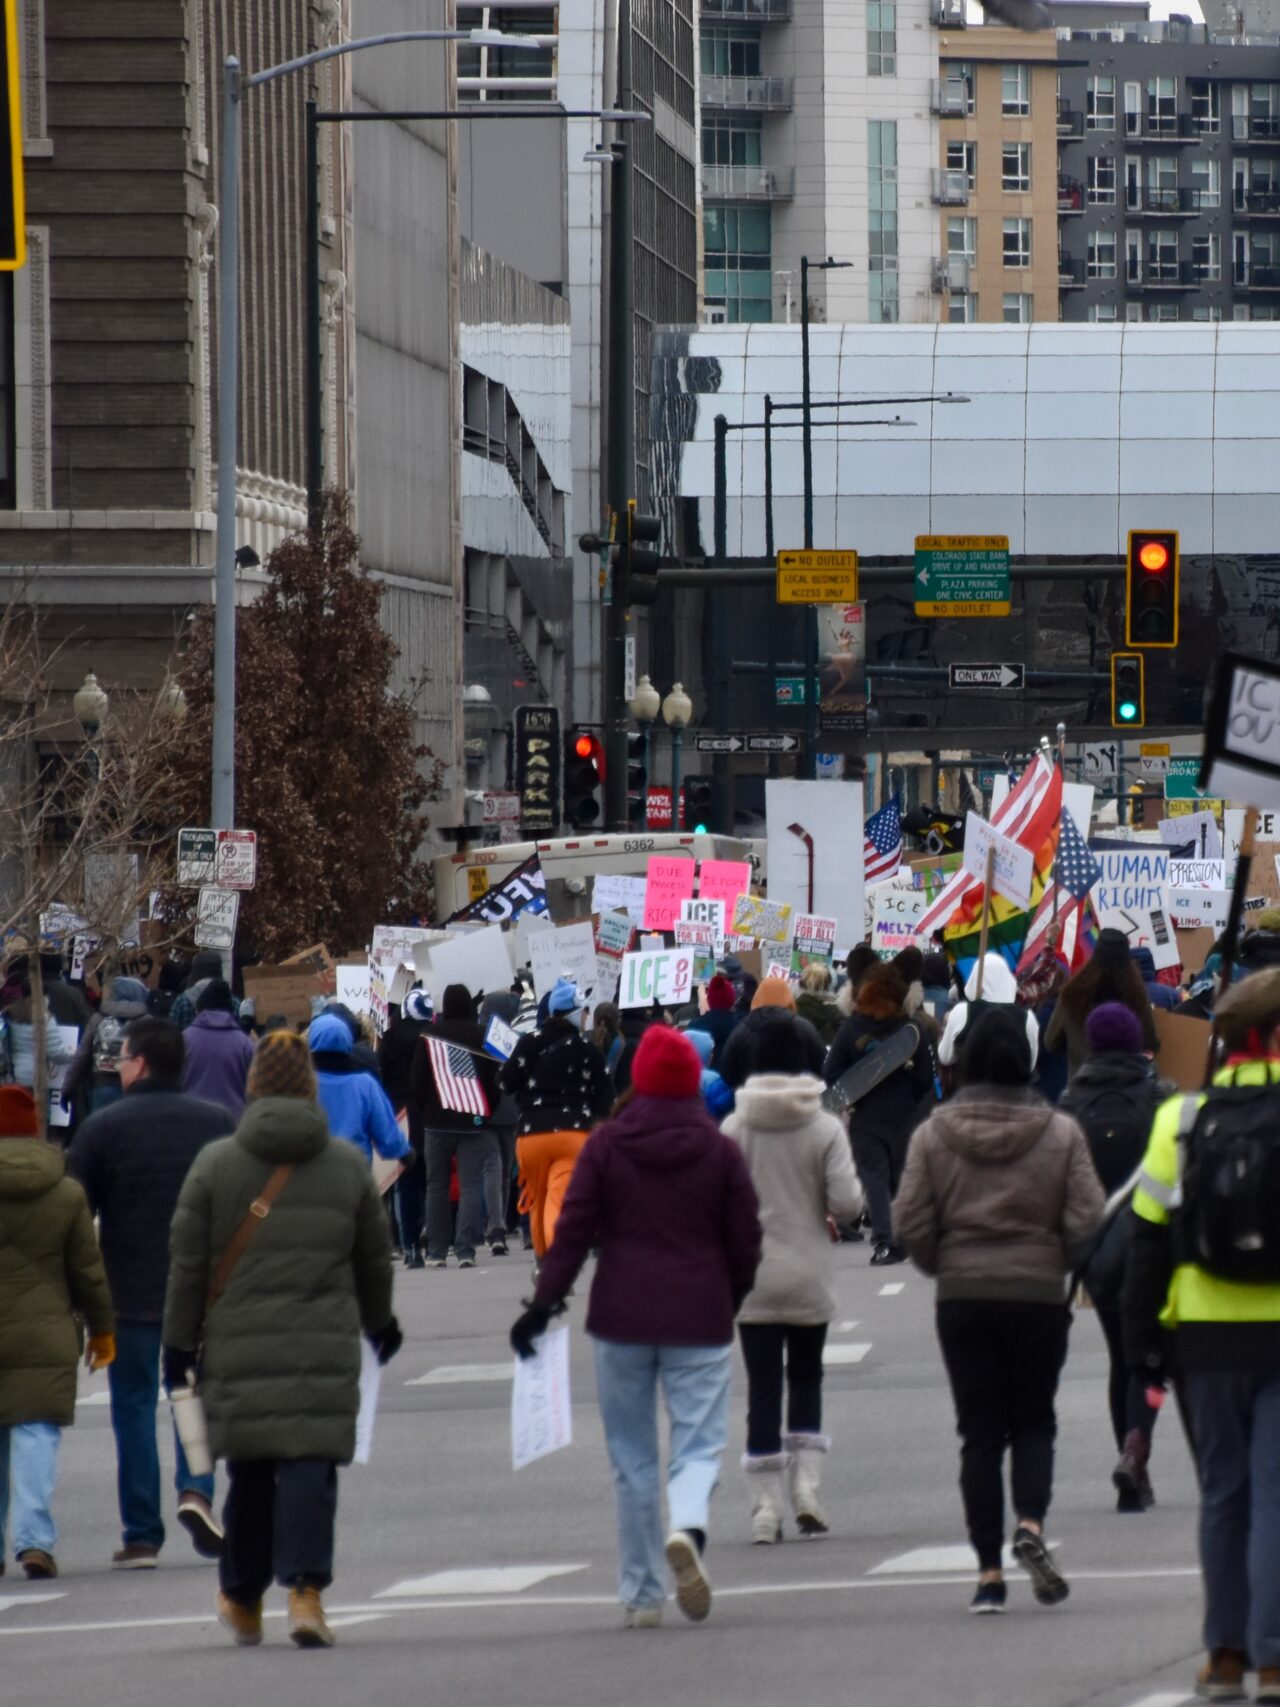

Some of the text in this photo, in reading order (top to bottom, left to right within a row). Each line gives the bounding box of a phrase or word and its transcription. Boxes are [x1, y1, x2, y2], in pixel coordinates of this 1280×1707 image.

[984, 537, 1006, 547] ONLY
[799, 554, 851, 566] NO OUTLET
[932, 551, 1007, 560] COLORADO STATE BANK
[932, 562, 1008, 571] DRIVE UP AND PARKING
[784, 574, 850, 584] LOCAL BUSINESS
[941, 580, 998, 589] PLAZA PARKING
[791, 588, 820, 598] ACCESS
[936, 590, 1004, 600] ONE CIVIC CENTER
[933, 604, 991, 614] NO OUTLET
[957, 670, 1001, 682] ONE WAY
[624, 839, 655, 852] 6362
[656, 866, 684, 877] DUE
[1169, 862, 1222, 884] PPRESSION
[1099, 886, 1163, 911] RIGHTS
[1175, 898, 1190, 908] ICE
[885, 897, 921, 914] ICE
[648, 908, 675, 923] RIGH
[686, 902, 719, 921] ICE
[795, 926, 813, 939] FOR
[628, 955, 670, 1002] ICE
